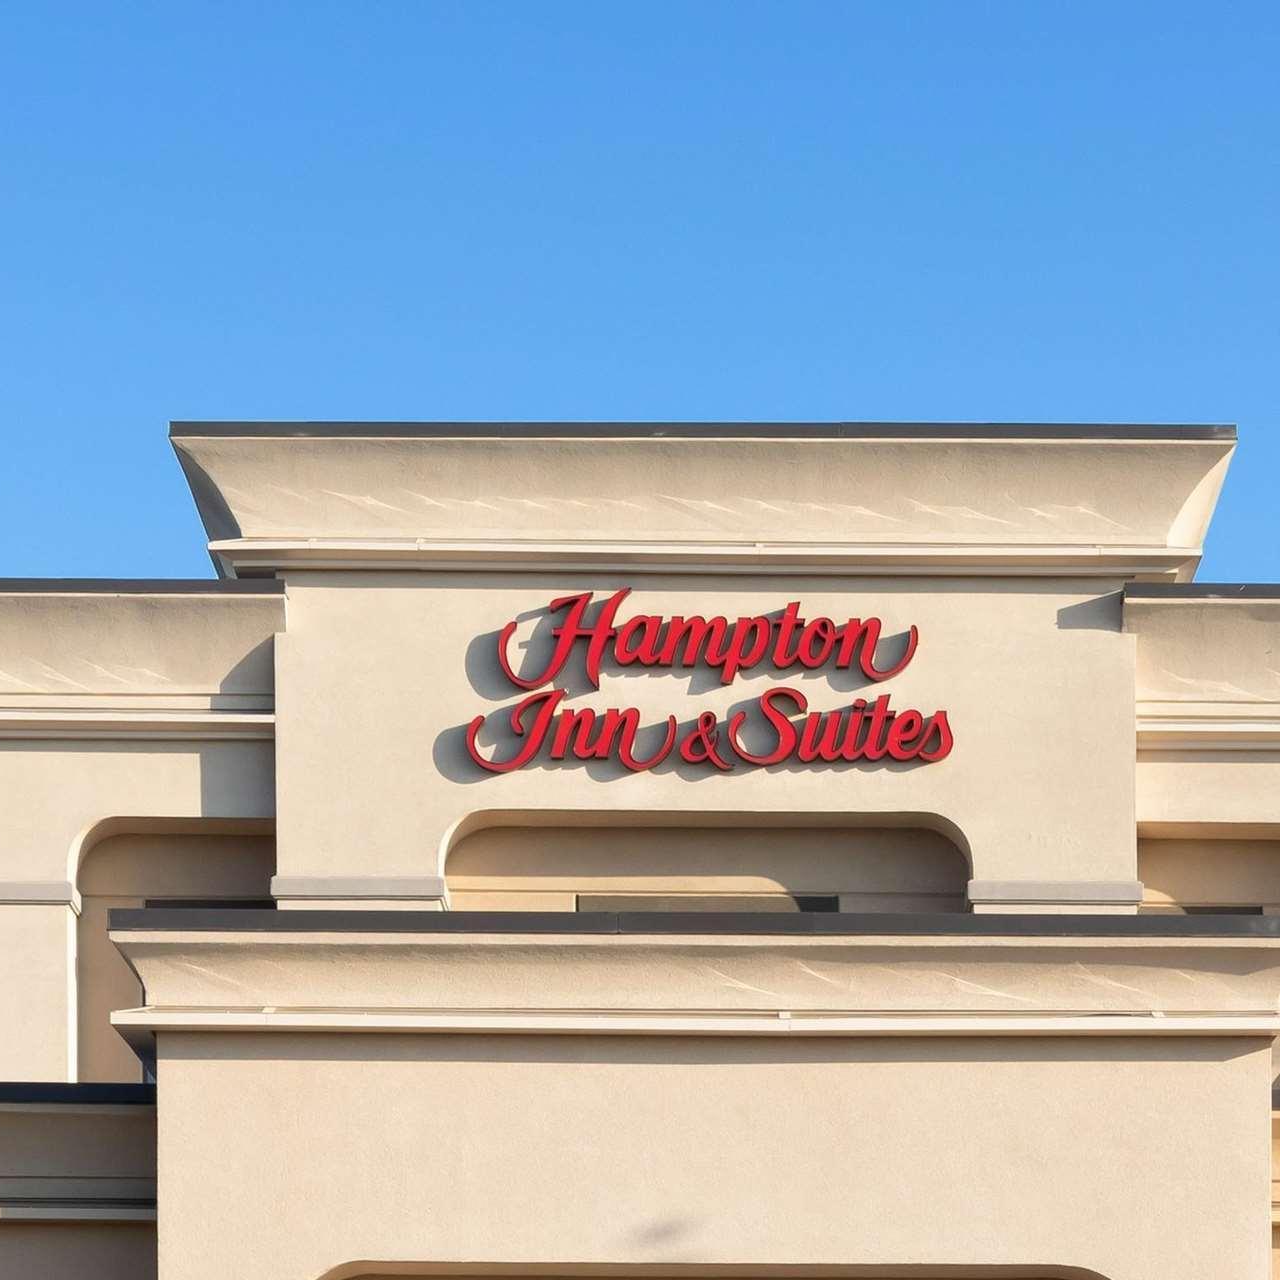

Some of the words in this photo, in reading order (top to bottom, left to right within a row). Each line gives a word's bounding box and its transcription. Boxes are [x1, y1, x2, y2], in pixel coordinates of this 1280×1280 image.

[498, 587, 919, 691] Hampton
[466, 689, 677, 773] Inn
[679, 711, 734, 771] &
[728, 686, 954, 767] Suites
